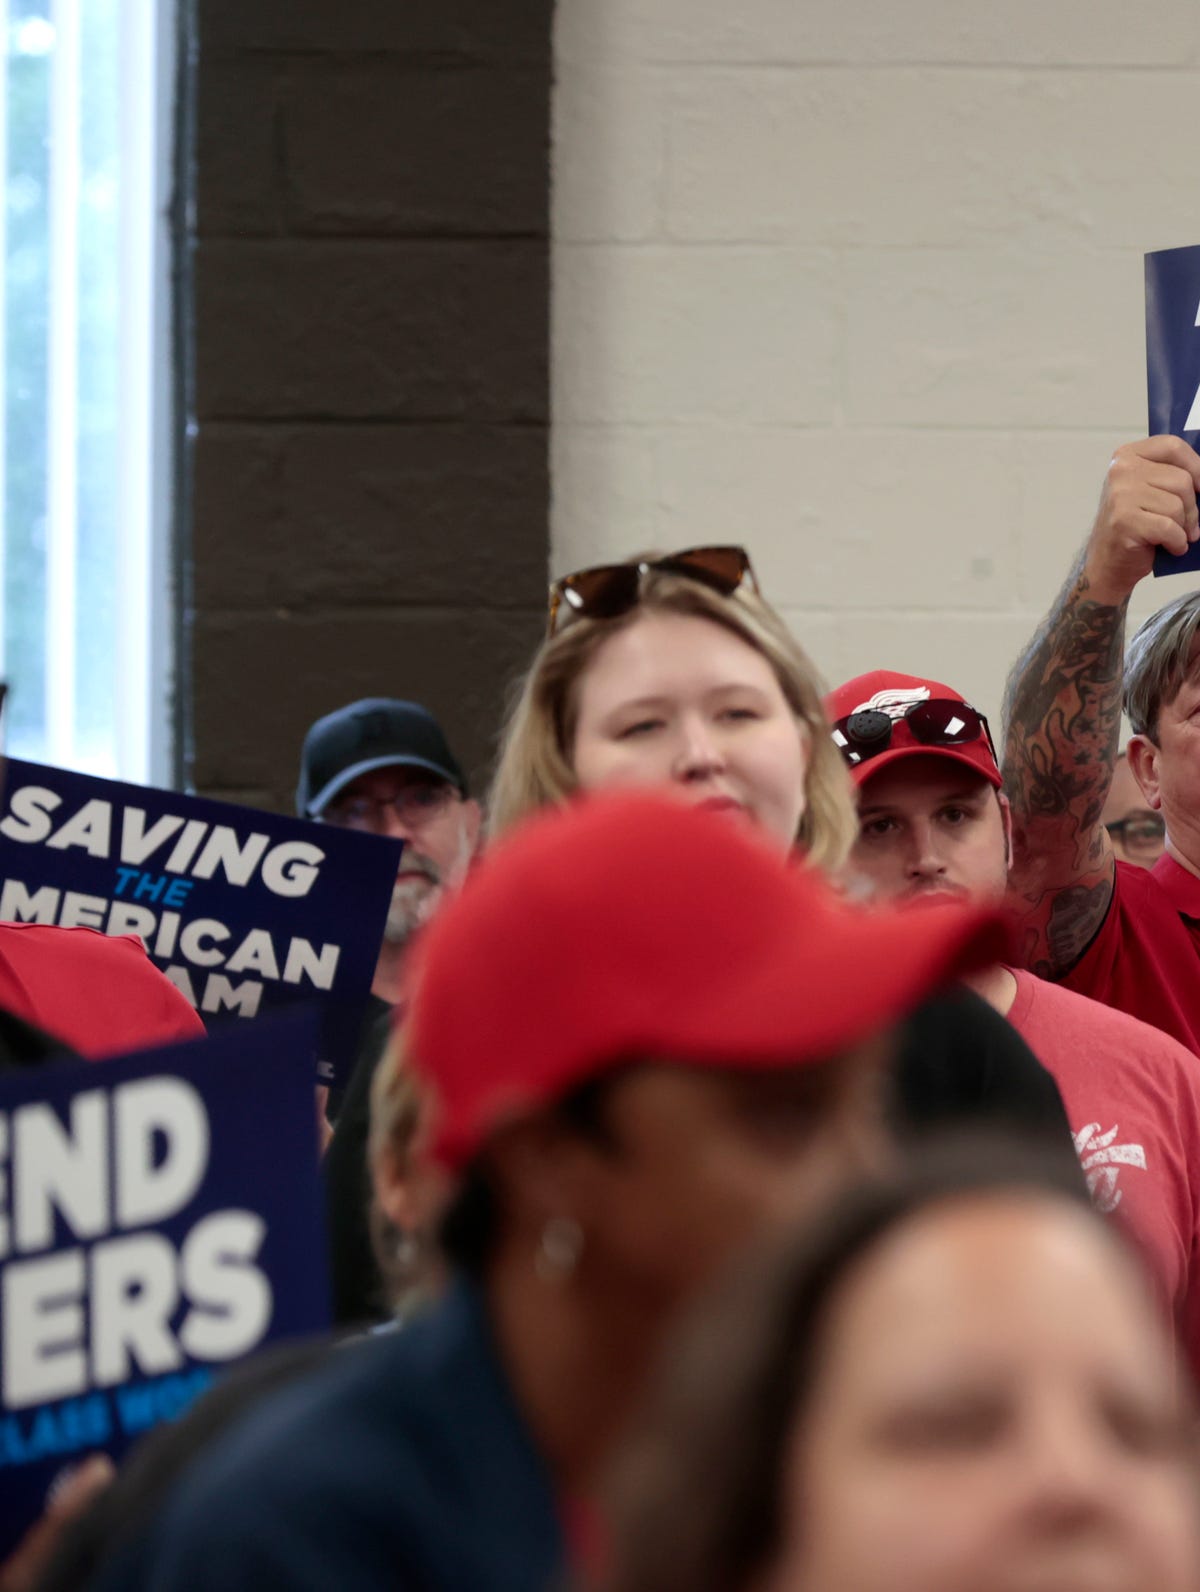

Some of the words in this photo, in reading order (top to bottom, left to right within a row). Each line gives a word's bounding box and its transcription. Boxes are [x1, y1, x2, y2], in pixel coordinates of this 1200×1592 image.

[0, 786, 326, 898] SAVING
[113, 867, 194, 907] THE
[0, 1074, 209, 1256] ND
